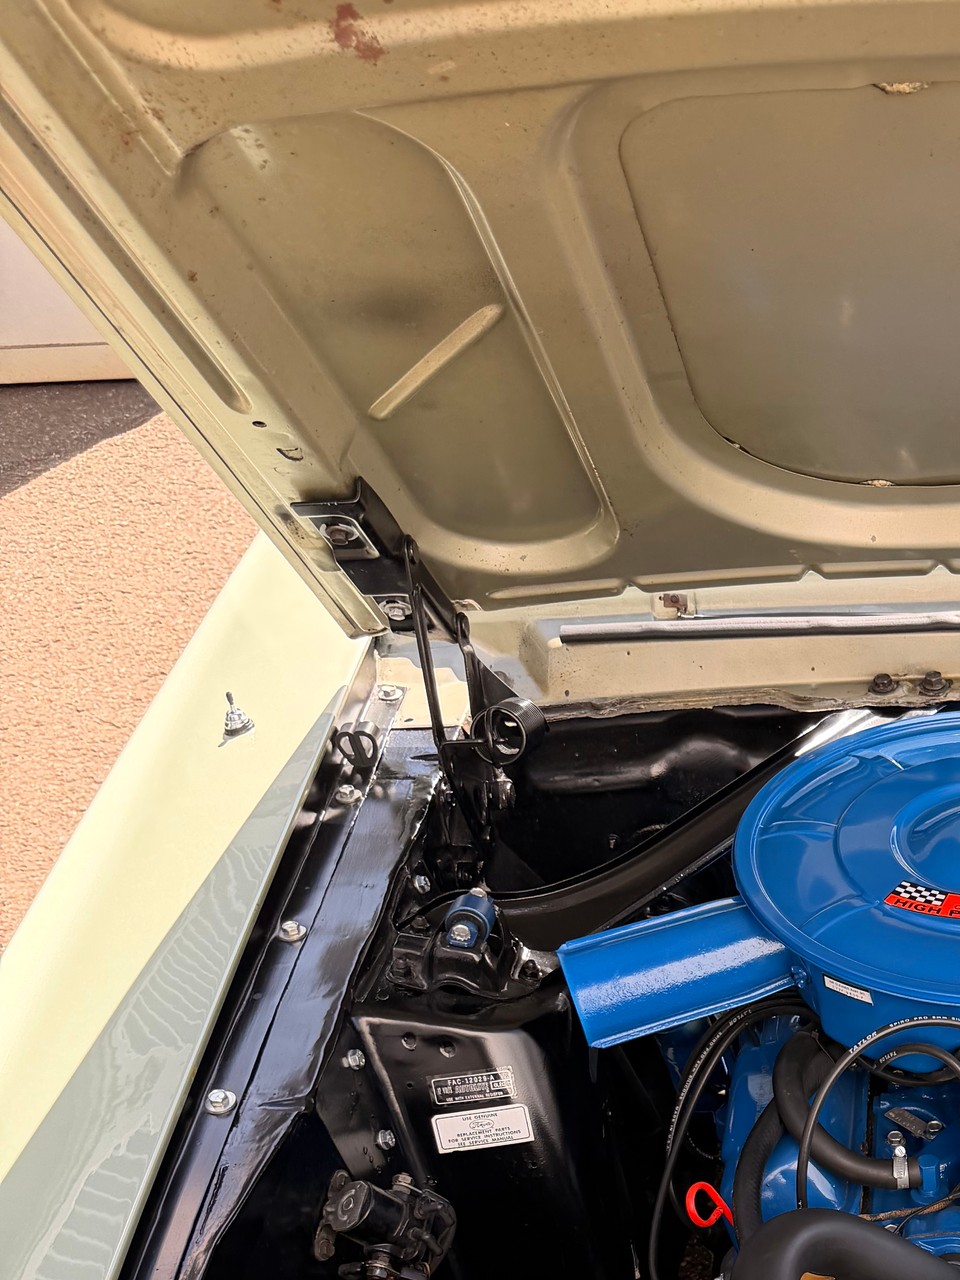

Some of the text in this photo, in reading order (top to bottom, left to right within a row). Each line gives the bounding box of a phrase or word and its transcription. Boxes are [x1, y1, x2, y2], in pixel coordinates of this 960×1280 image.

[893, 899, 942, 914] HIGH
[848, 1031, 878, 1054] TAYLOR
[889, 1018, 911, 1028] SPIRO
[457, 1129, 492, 1137] REPLACEMENT
[484, 1130, 521, 1138] INSTRUCTIONS
